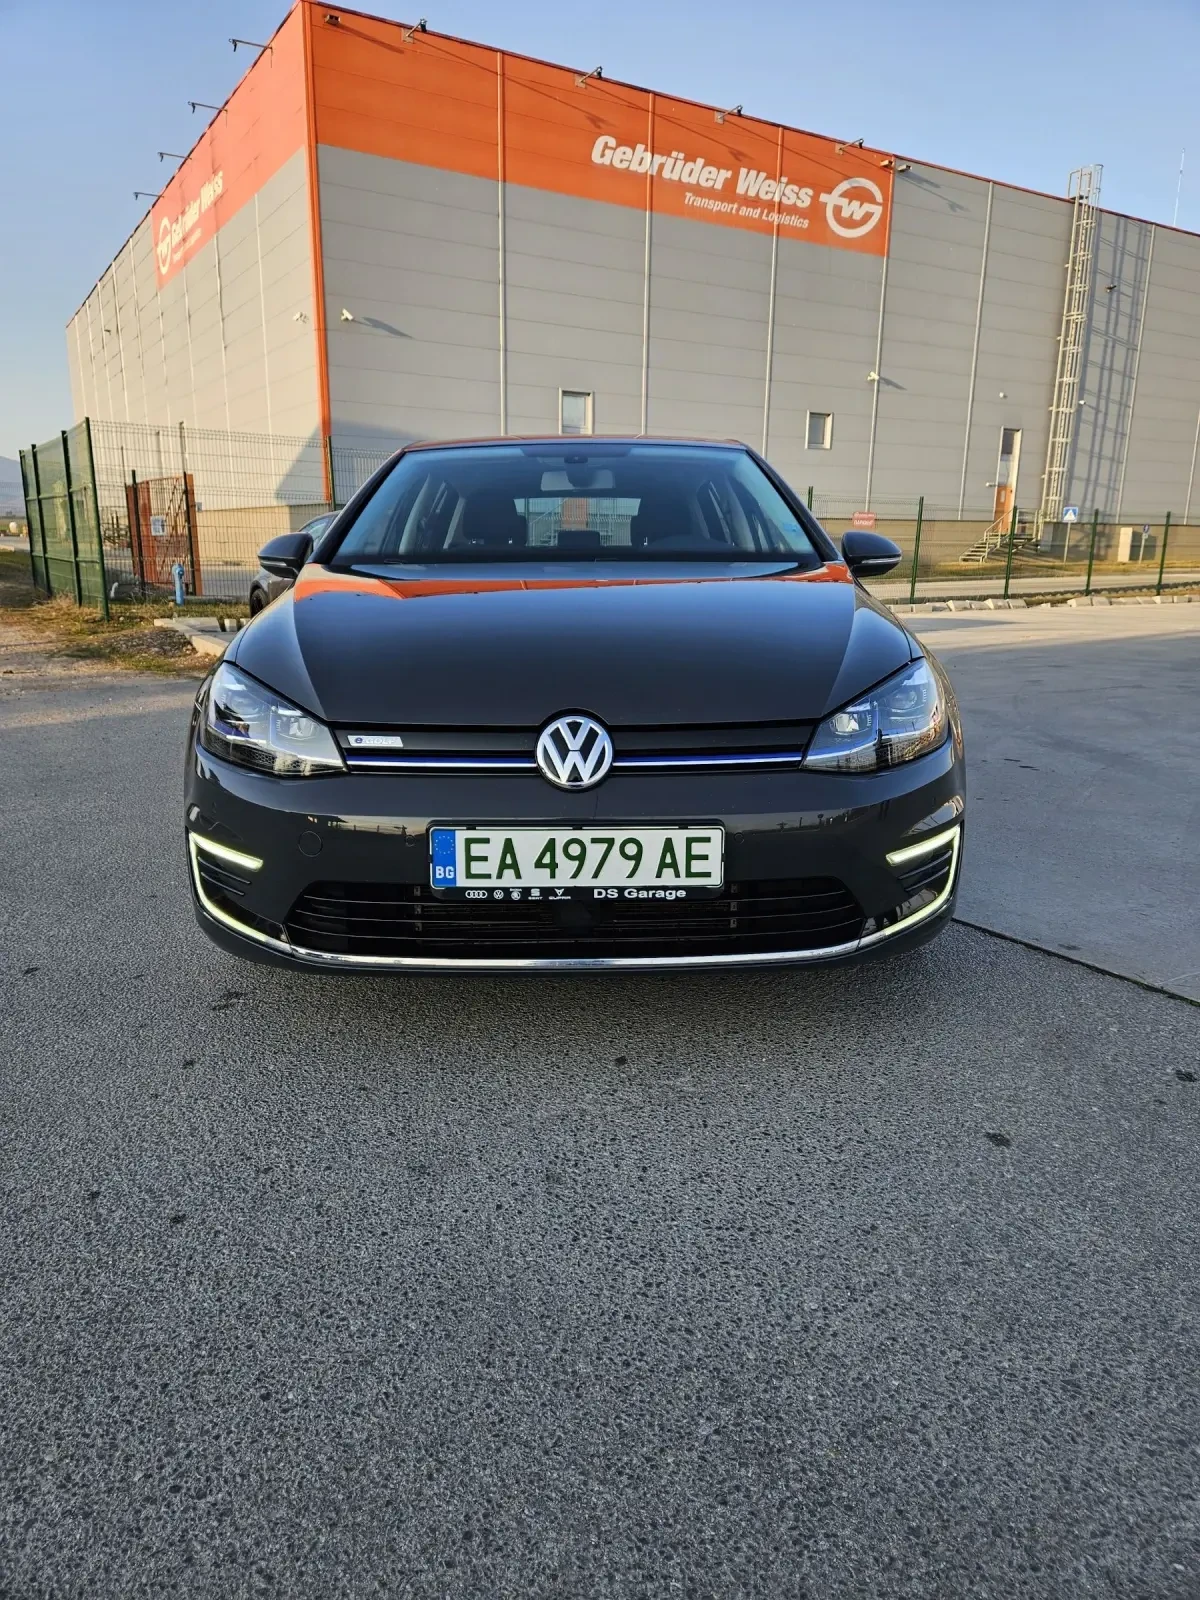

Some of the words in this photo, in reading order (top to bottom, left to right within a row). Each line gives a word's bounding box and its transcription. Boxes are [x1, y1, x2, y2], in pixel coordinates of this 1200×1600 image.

[592, 135, 732, 190] Gebrüder
[736, 167, 814, 208] Weiss
[684, 192, 738, 213] Transport
[739, 206, 761, 218] and
[762, 209, 809, 229] Logistics
[435, 866, 455, 879] BG
[464, 837, 522, 879] EA
[534, 837, 643, 879] 4979
[655, 836, 712, 878] AE
[593, 888, 619, 898] DS
[624, 888, 687, 900] Garage
